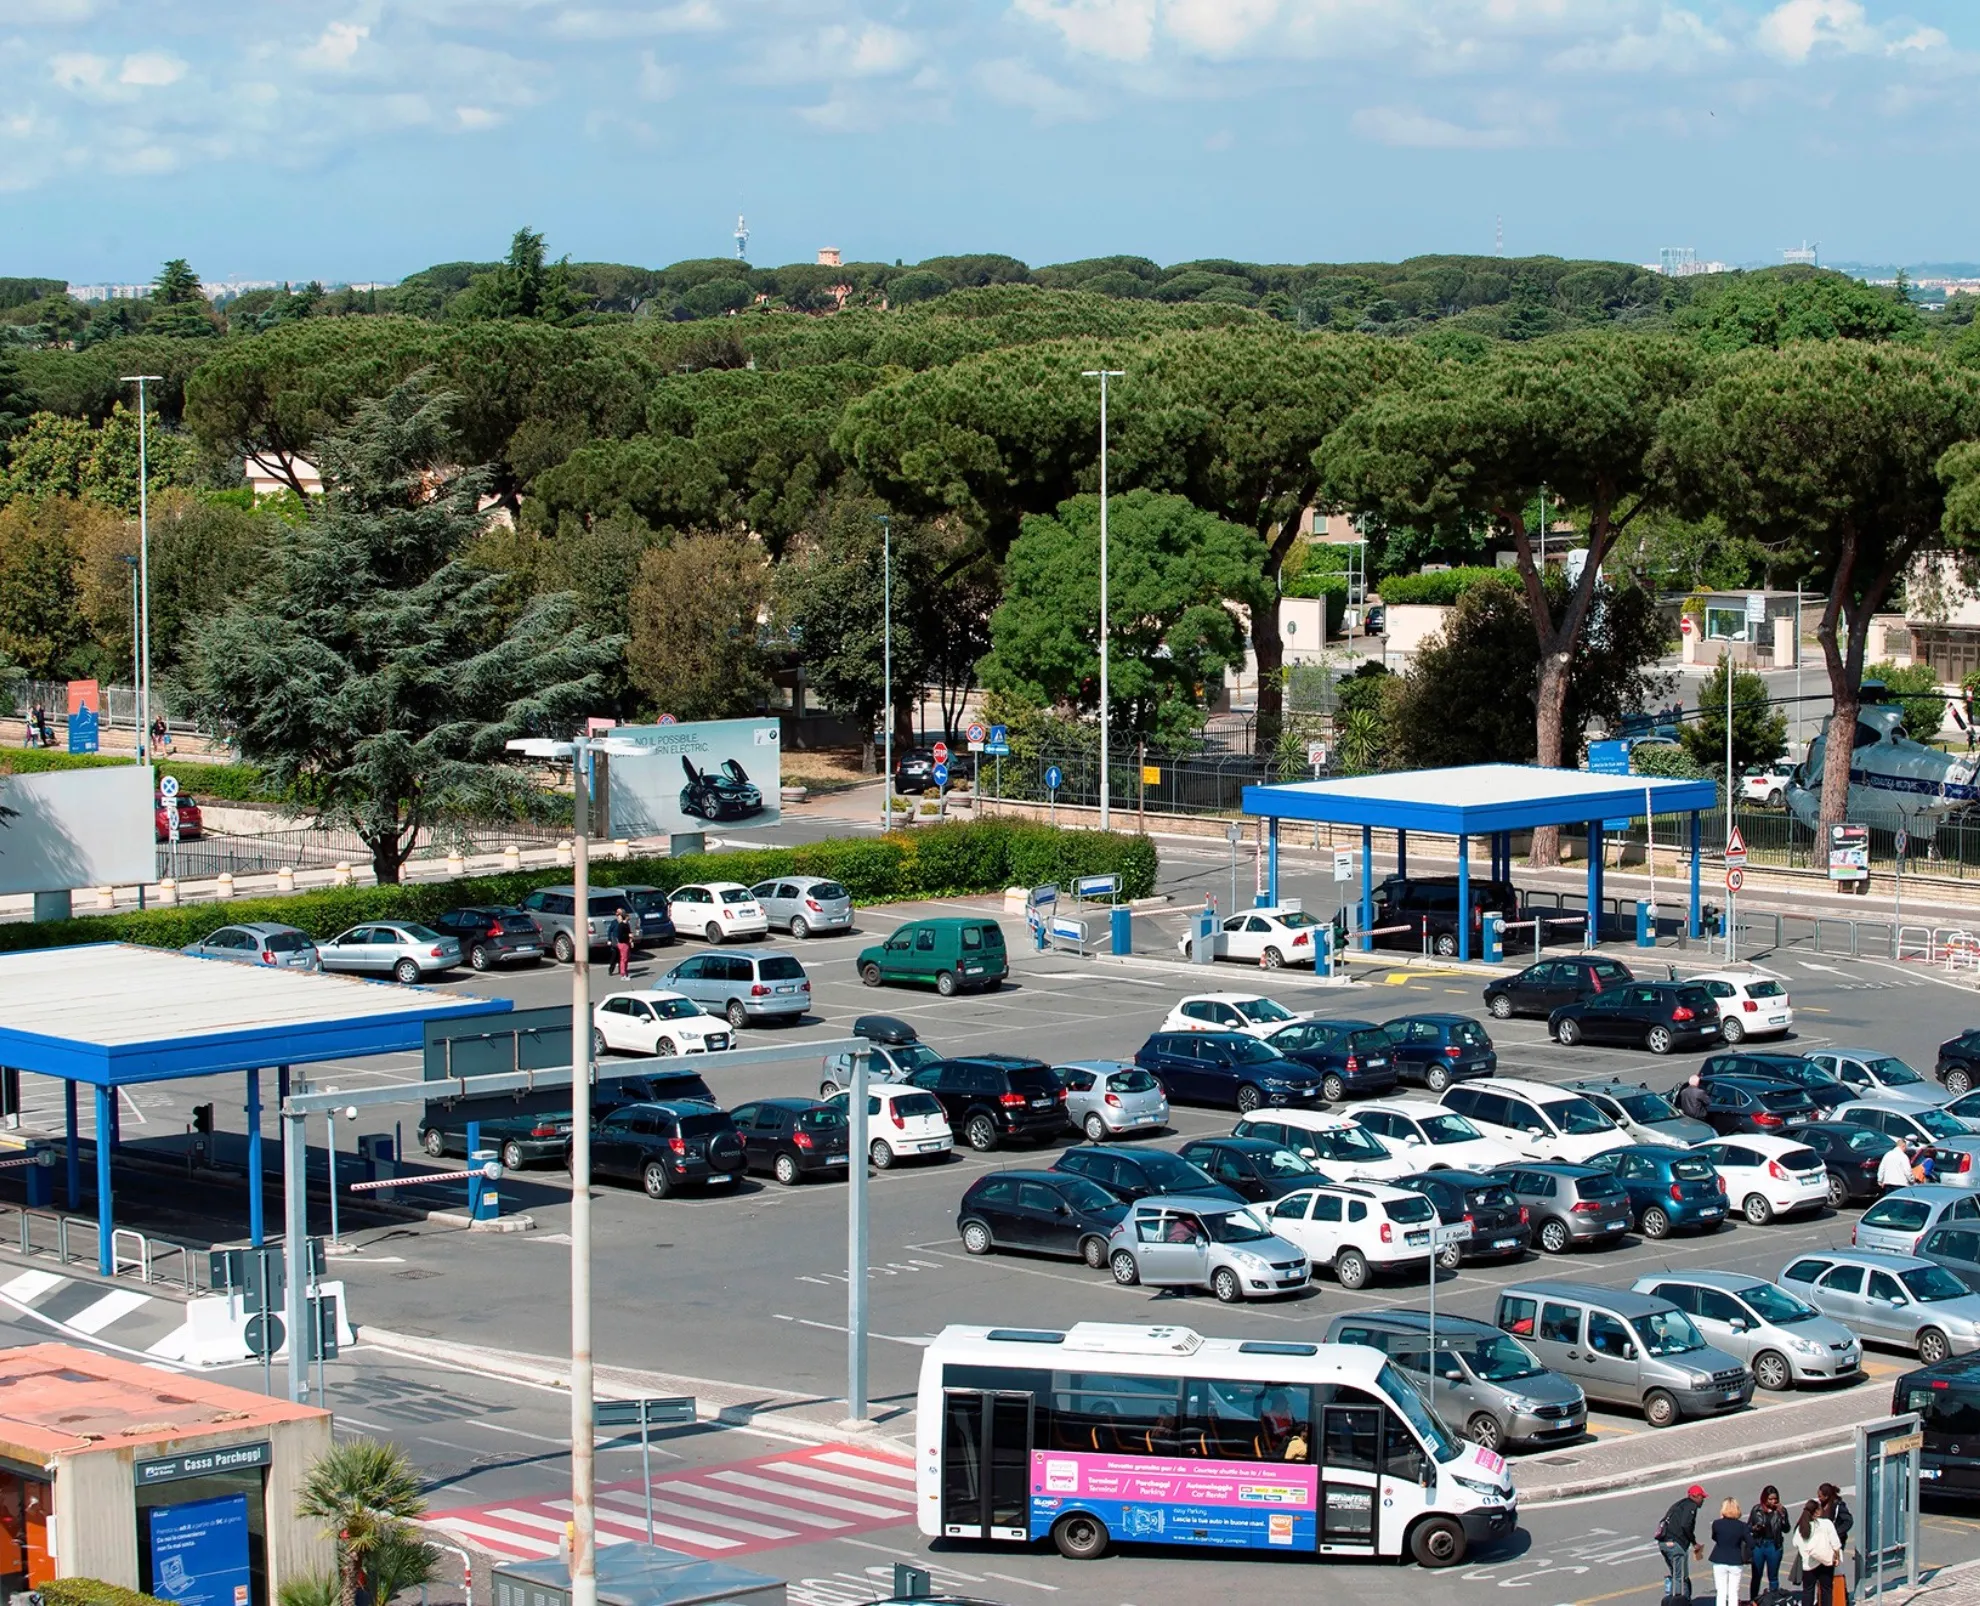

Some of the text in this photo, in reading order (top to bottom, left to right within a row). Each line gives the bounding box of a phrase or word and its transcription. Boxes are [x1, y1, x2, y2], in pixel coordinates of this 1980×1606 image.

[933, 749, 948, 757] STOP
[1732, 873, 1740, 885] 10
[184, 1447, 261, 1471] Cassa Parcheggi
[1088, 1477, 1119, 1485] Terminal
[1135, 1479, 1171, 1488] Parcheggi
[1089, 1485, 1118, 1493] Terminal
[1140, 1487, 1166, 1497] Parking
[1205, 1491, 1228, 1499] Rental
